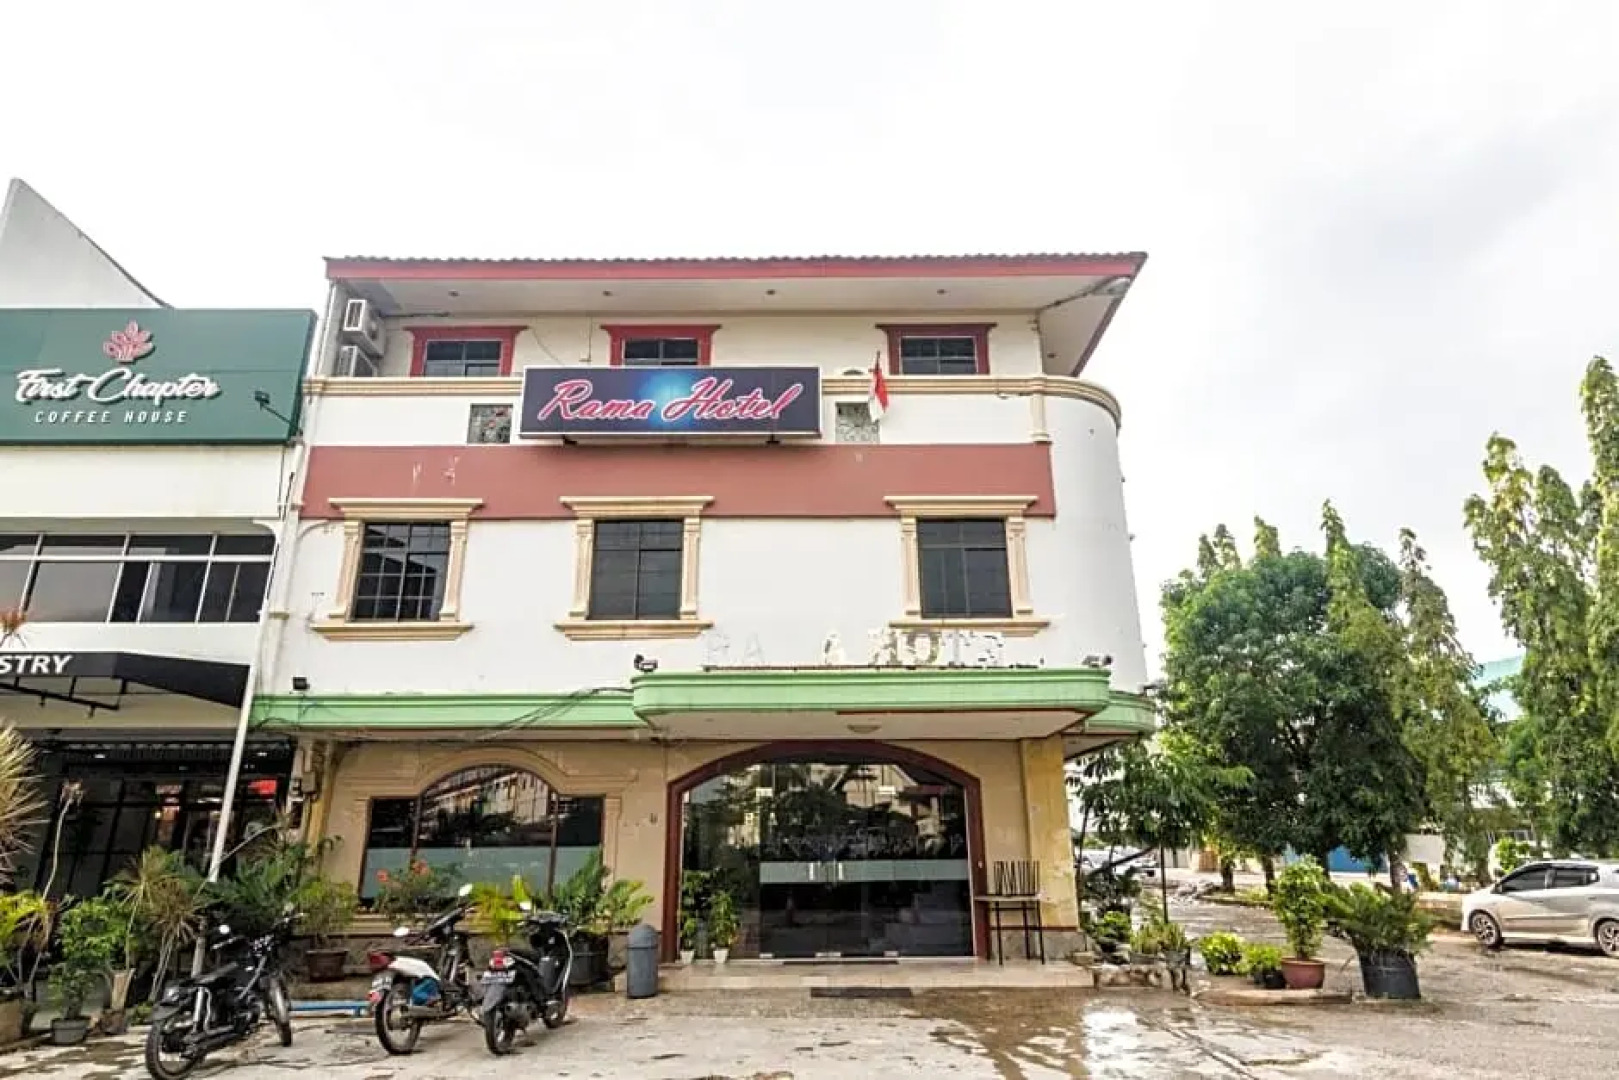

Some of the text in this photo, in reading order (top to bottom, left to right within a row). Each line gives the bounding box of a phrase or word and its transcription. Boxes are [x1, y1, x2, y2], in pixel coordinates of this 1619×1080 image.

[16, 366, 220, 406] First Chapter
[537, 376, 803, 422] Rama Hotel
[35, 411, 188, 423] COFFEE HOUSE
[0, 653, 73, 674] STRY
